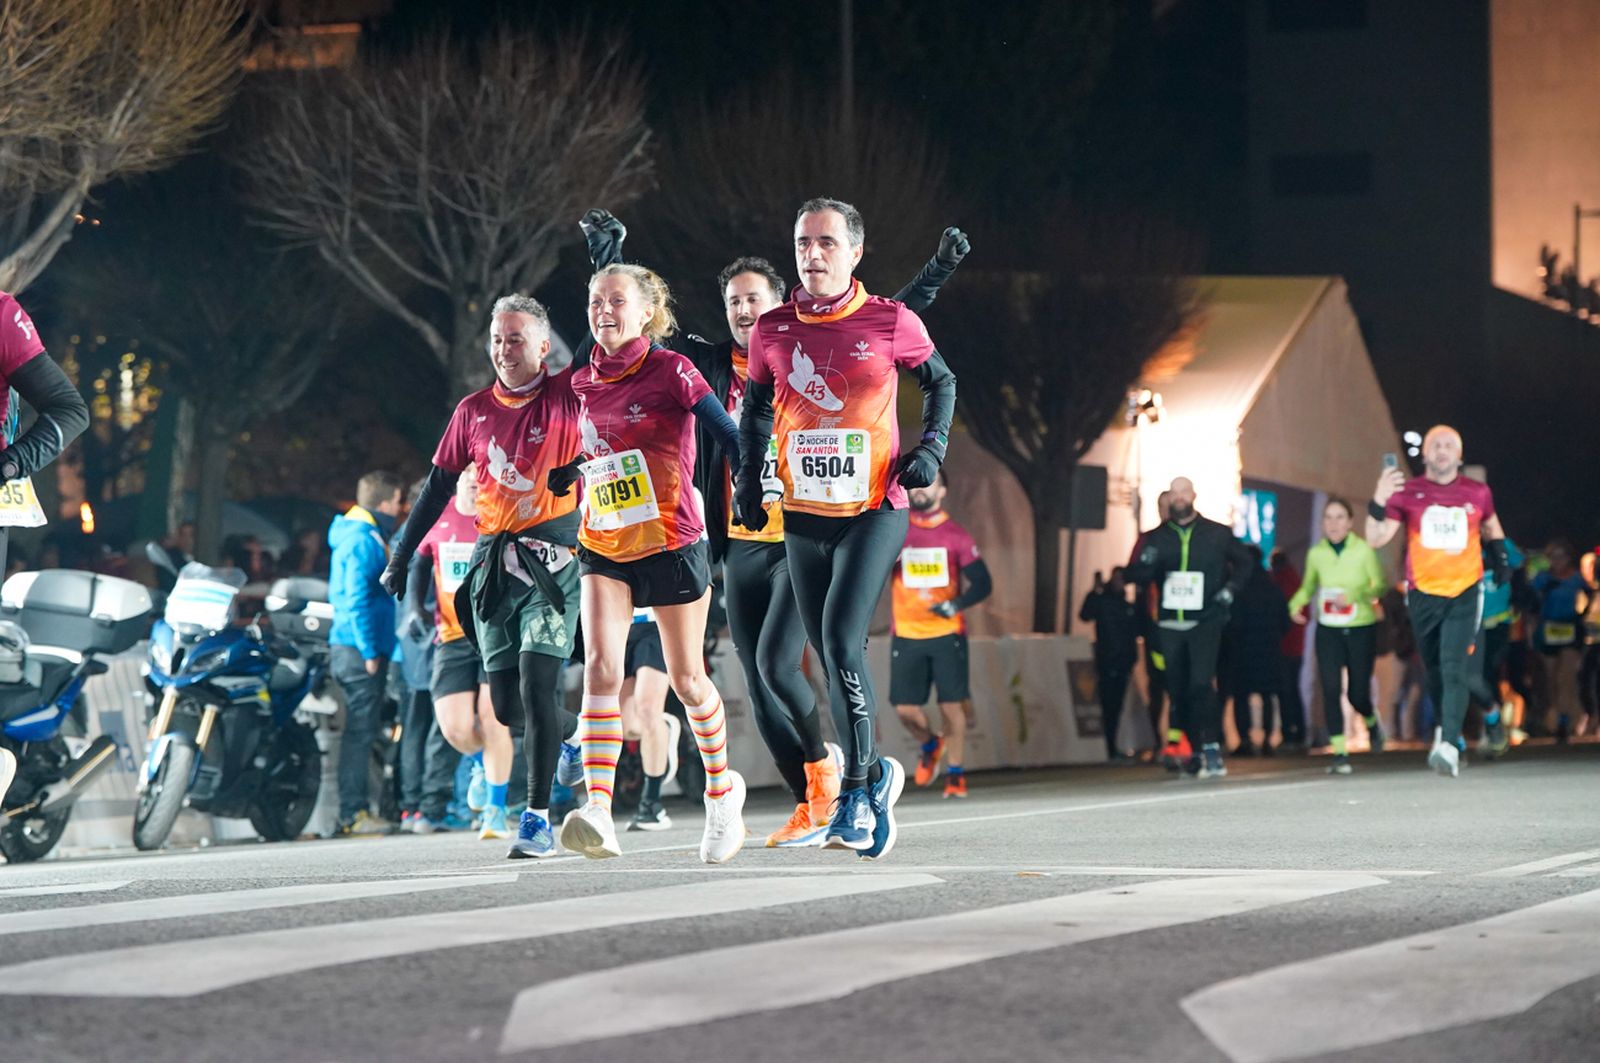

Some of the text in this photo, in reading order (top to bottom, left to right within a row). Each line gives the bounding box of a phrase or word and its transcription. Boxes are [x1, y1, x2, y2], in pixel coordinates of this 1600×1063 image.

[804, 381, 825, 401] 43
[806, 437, 839, 445] NOCHE DE
[796, 447, 811, 455] SAN
[607, 463, 616, 472] DE
[801, 456, 856, 478] 6504
[500, 468, 517, 485] 43
[594, 476, 642, 507] 13791
[840, 668, 869, 716] NIKE
